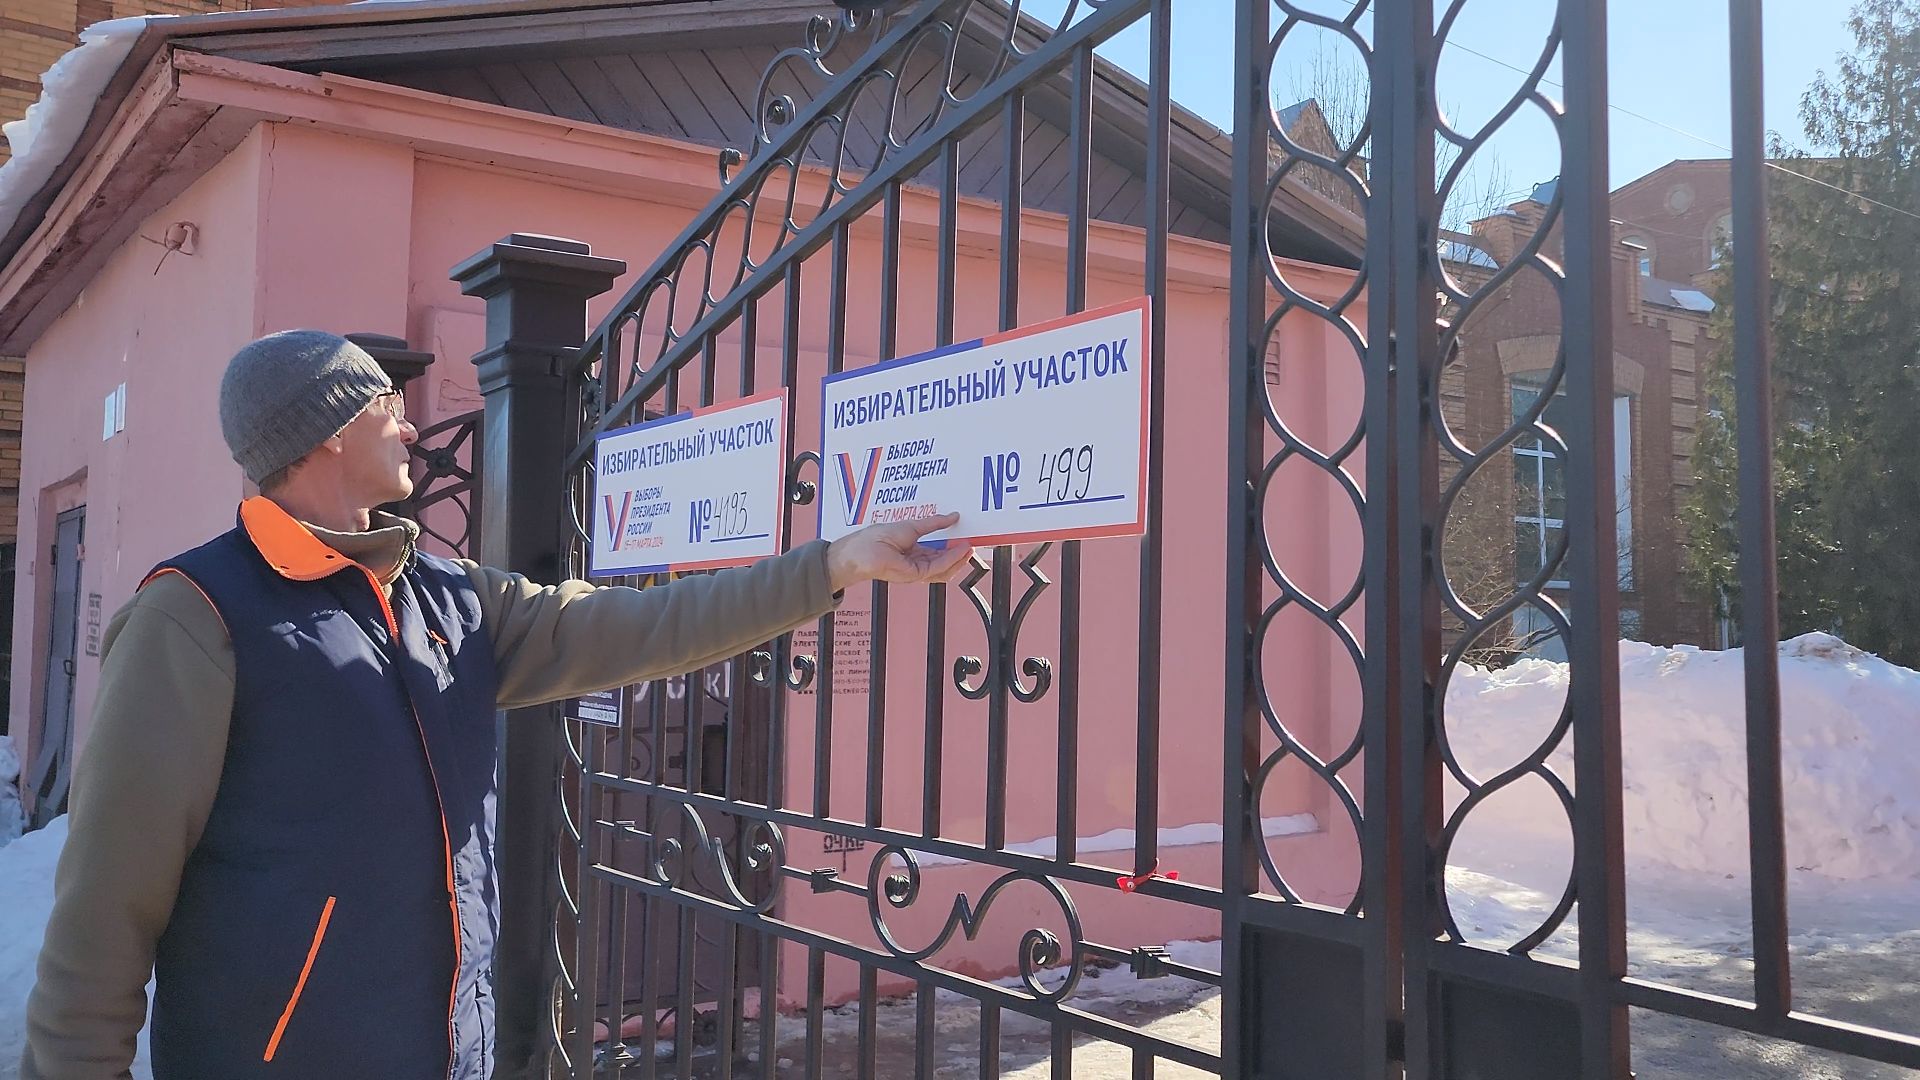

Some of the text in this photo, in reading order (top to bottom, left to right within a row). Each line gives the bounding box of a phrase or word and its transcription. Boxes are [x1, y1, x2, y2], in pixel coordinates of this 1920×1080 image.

[833, 338, 1128, 430] ИЗБИРАТЕЛЬНЫЙ УЧАСТОК
[602, 418, 774, 476] ИЗБИРАТЕЛЬНЫЙ УЧАСТОК
[886, 438, 935, 461] ВЫБОРЫ
[881, 458, 949, 483] ПРЕЗИДЕНТА
[981, 444, 1094, 512] № 499
[634, 486, 664, 502] ВЫБОРЫ
[875, 485, 918, 505] РОССИИ
[630, 502, 671, 519] ПРЕЗИДЕНТА
[892, 506, 917, 522] МАРТА
[626, 521, 653, 536] РОССИИ
